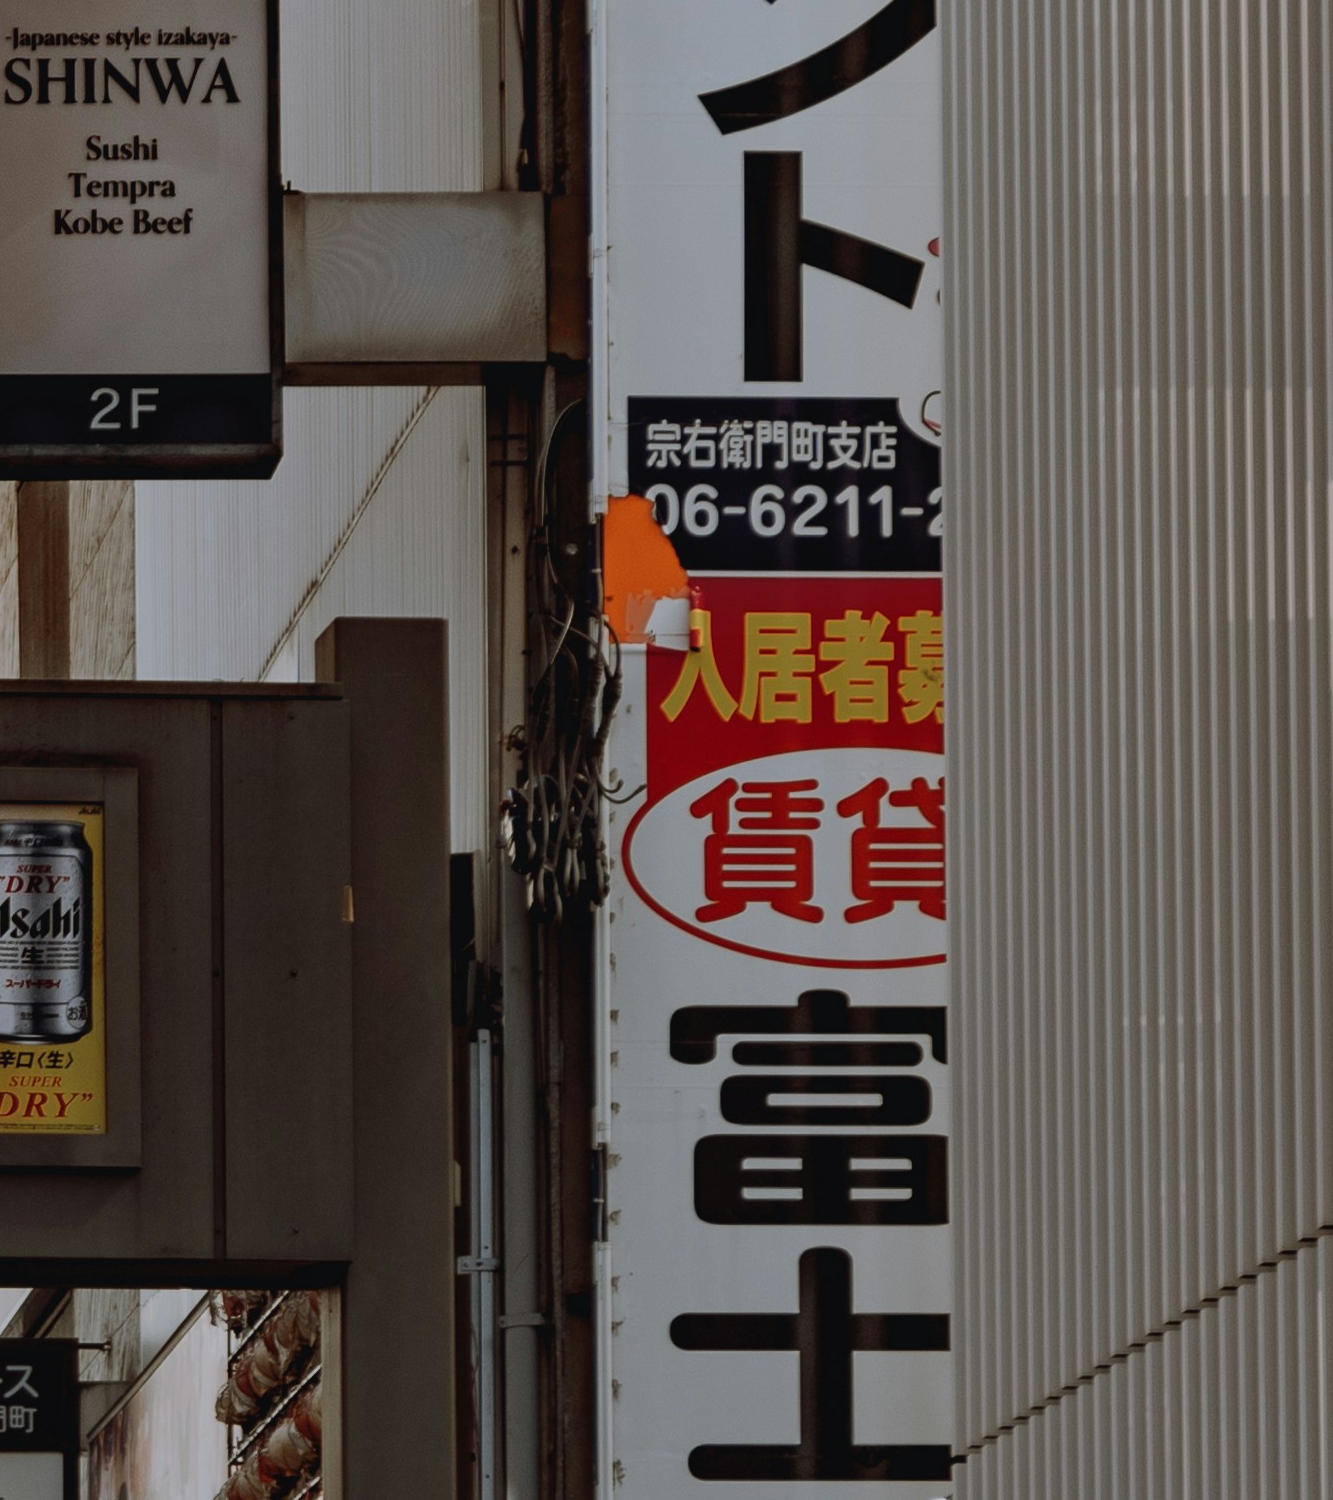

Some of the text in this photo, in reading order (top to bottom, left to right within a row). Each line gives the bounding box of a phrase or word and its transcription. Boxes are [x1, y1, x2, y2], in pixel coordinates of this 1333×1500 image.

[106, 27, 151, 50] style
[3, 56, 241, 105] SHINWA
[85, 134, 158, 161] Sushi
[67, 171, 176, 204] Tempra
[53, 208, 193, 236] Kobe Beef
[89, 386, 160, 430] 2F
[645, 419, 898, 471] 宗右衛門町支店
[689, 777, 948, 924] 賃貸
[16, 864, 52, 874] SUPER
[20, 946, 44, 964] 生
[5, 978, 62, 989] スーパードライ
[8, 1075, 62, 1087] SUPER
